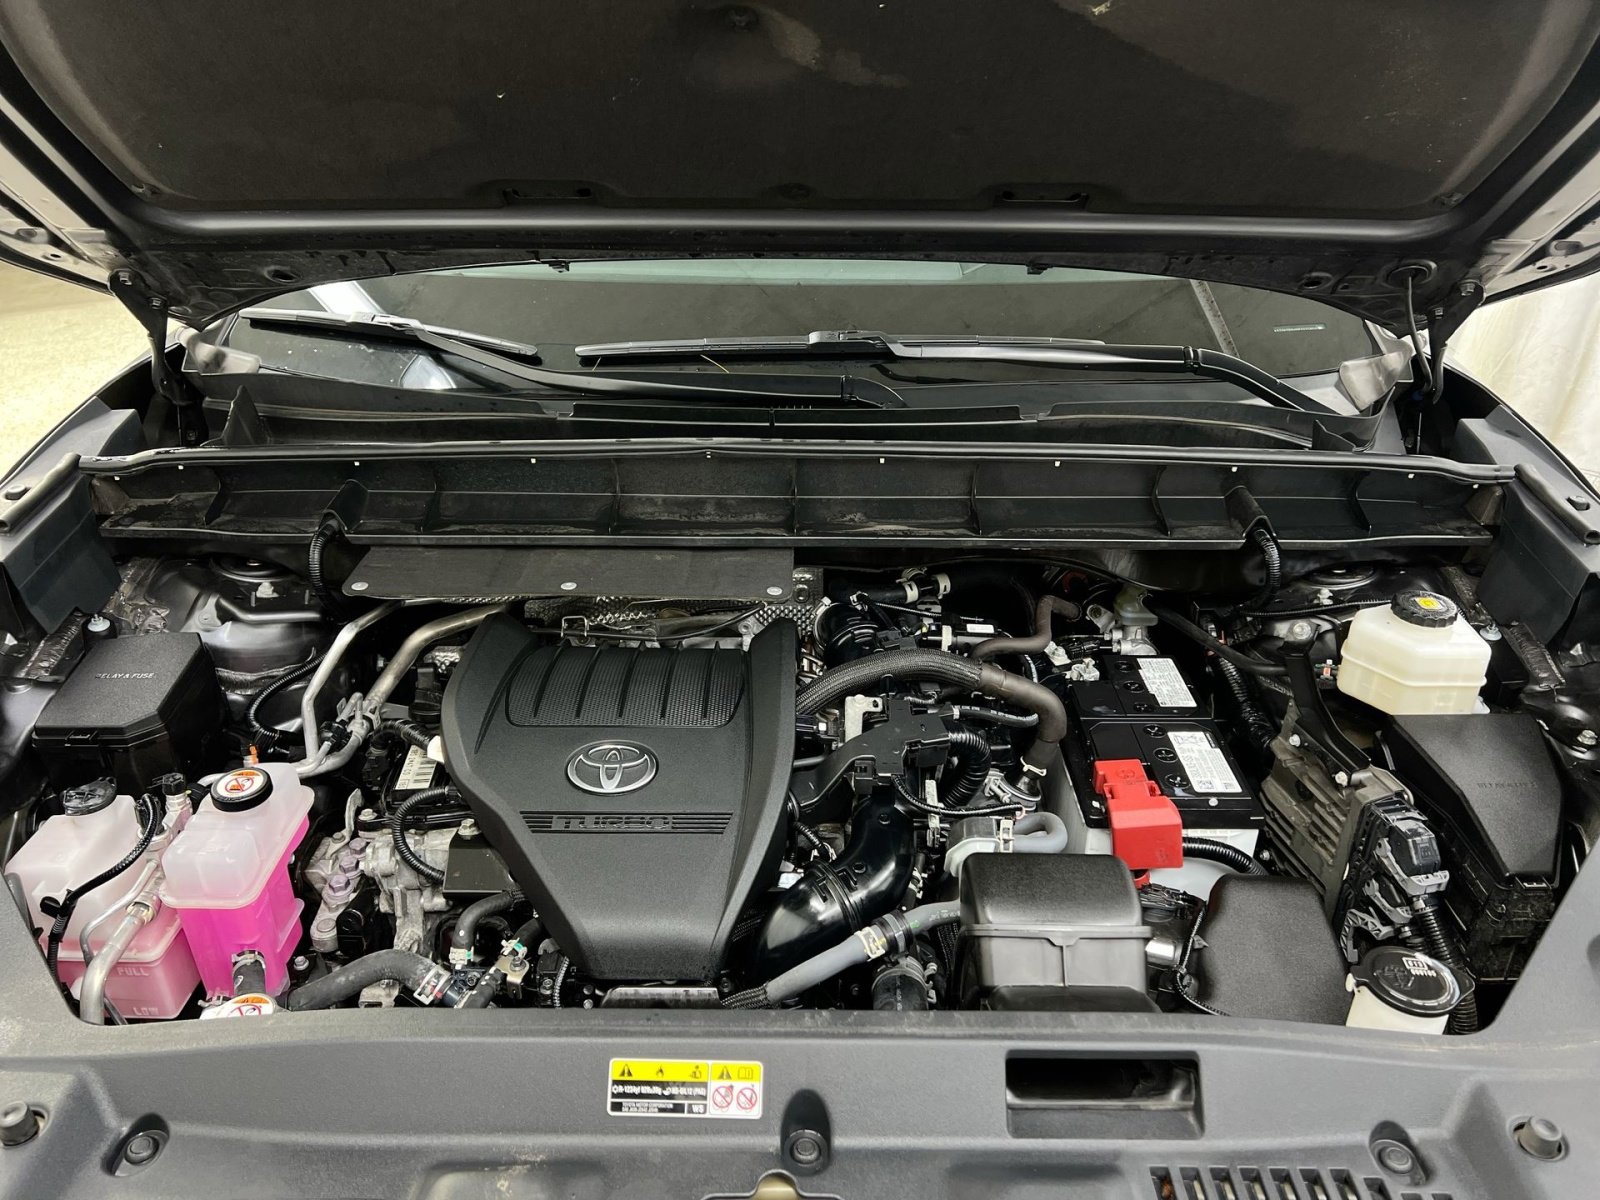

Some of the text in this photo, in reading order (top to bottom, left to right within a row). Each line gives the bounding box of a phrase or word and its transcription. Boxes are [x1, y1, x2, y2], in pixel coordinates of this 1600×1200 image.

[556, 815, 670, 829] TURBO
[116, 967, 149, 977] FULL
[133, 1007, 160, 1016] LOW
